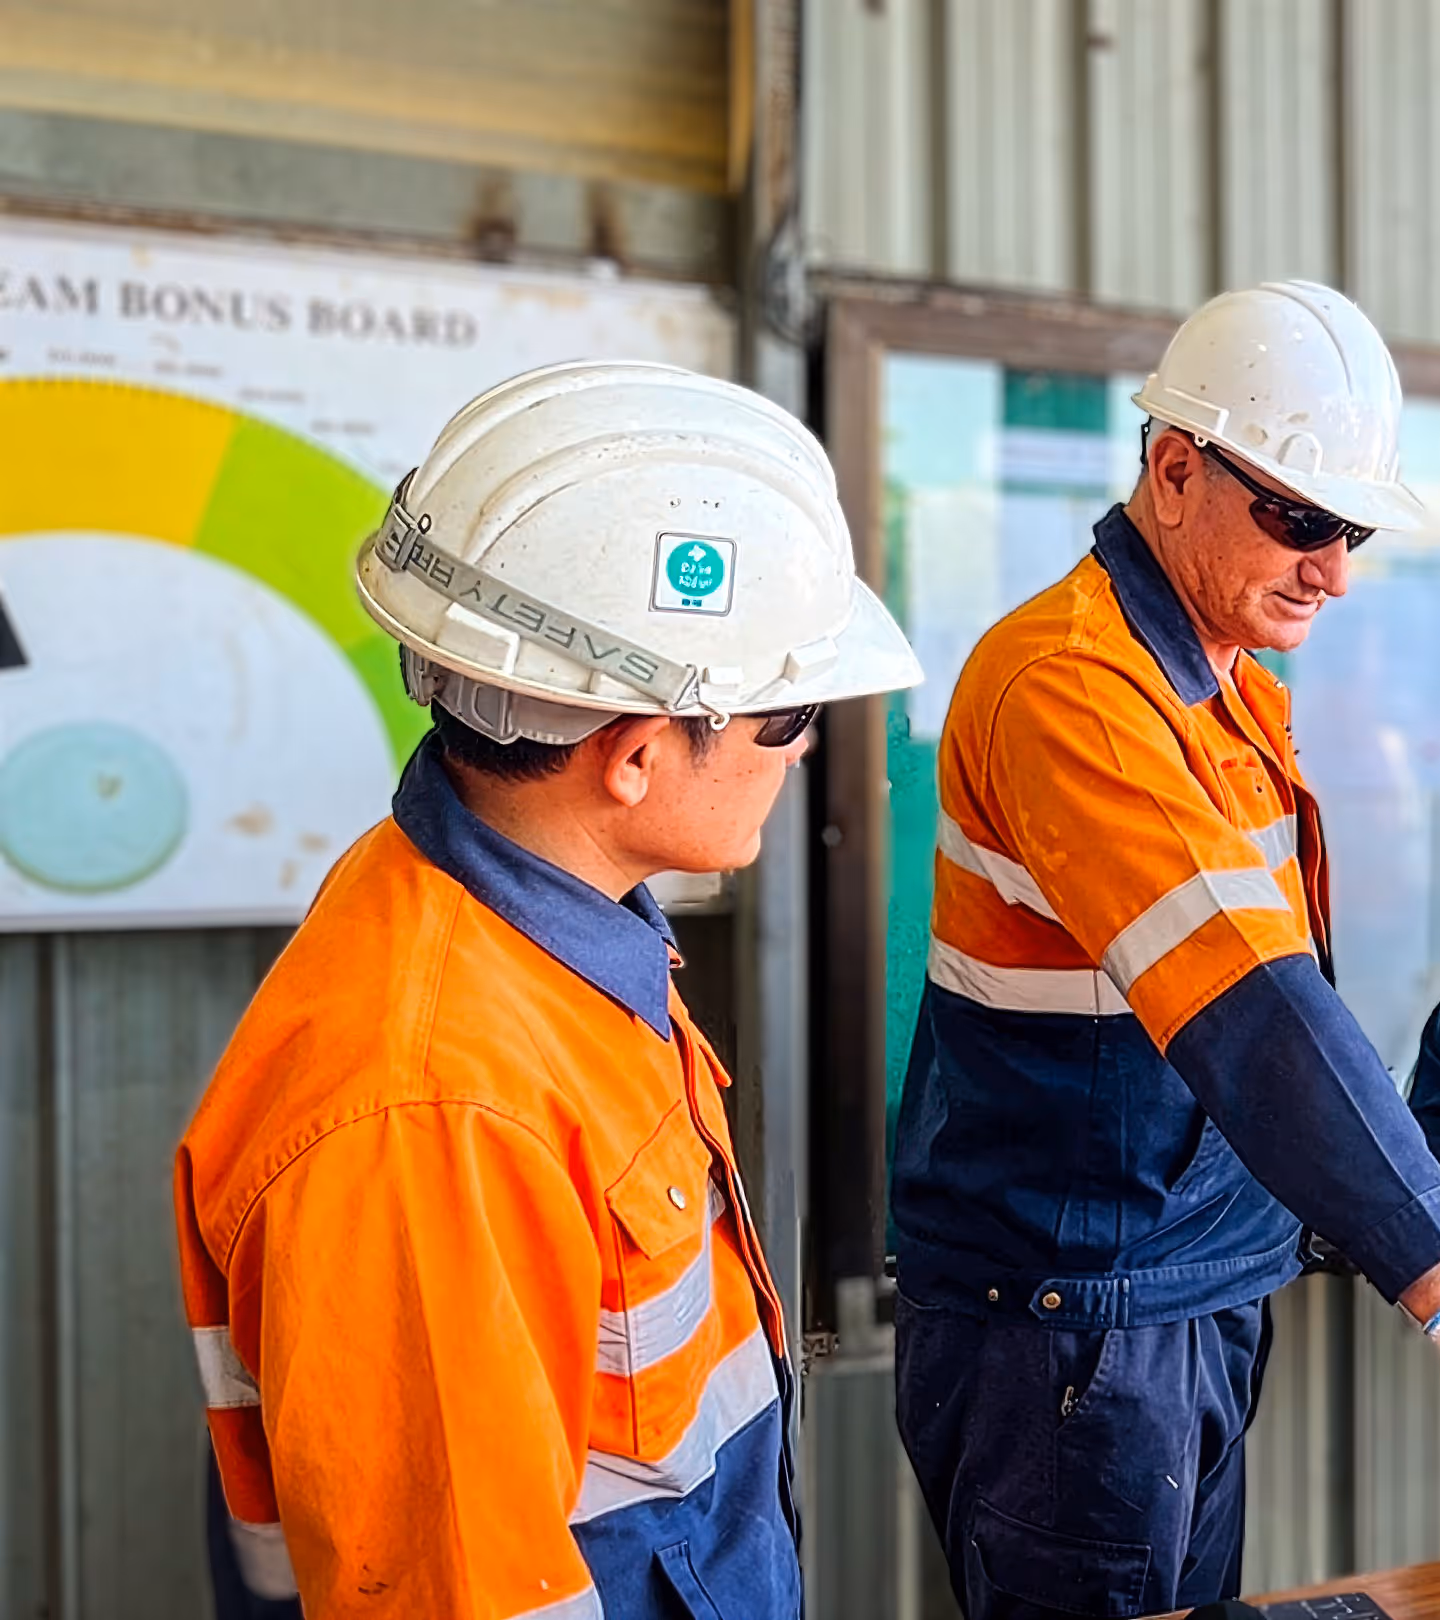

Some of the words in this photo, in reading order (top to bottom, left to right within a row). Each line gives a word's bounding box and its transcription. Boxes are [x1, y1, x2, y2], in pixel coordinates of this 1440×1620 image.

[119, 281, 291, 333] BONUS
[307, 297, 477, 347] BOARD
[460, 580, 658, 684] SAFETY
